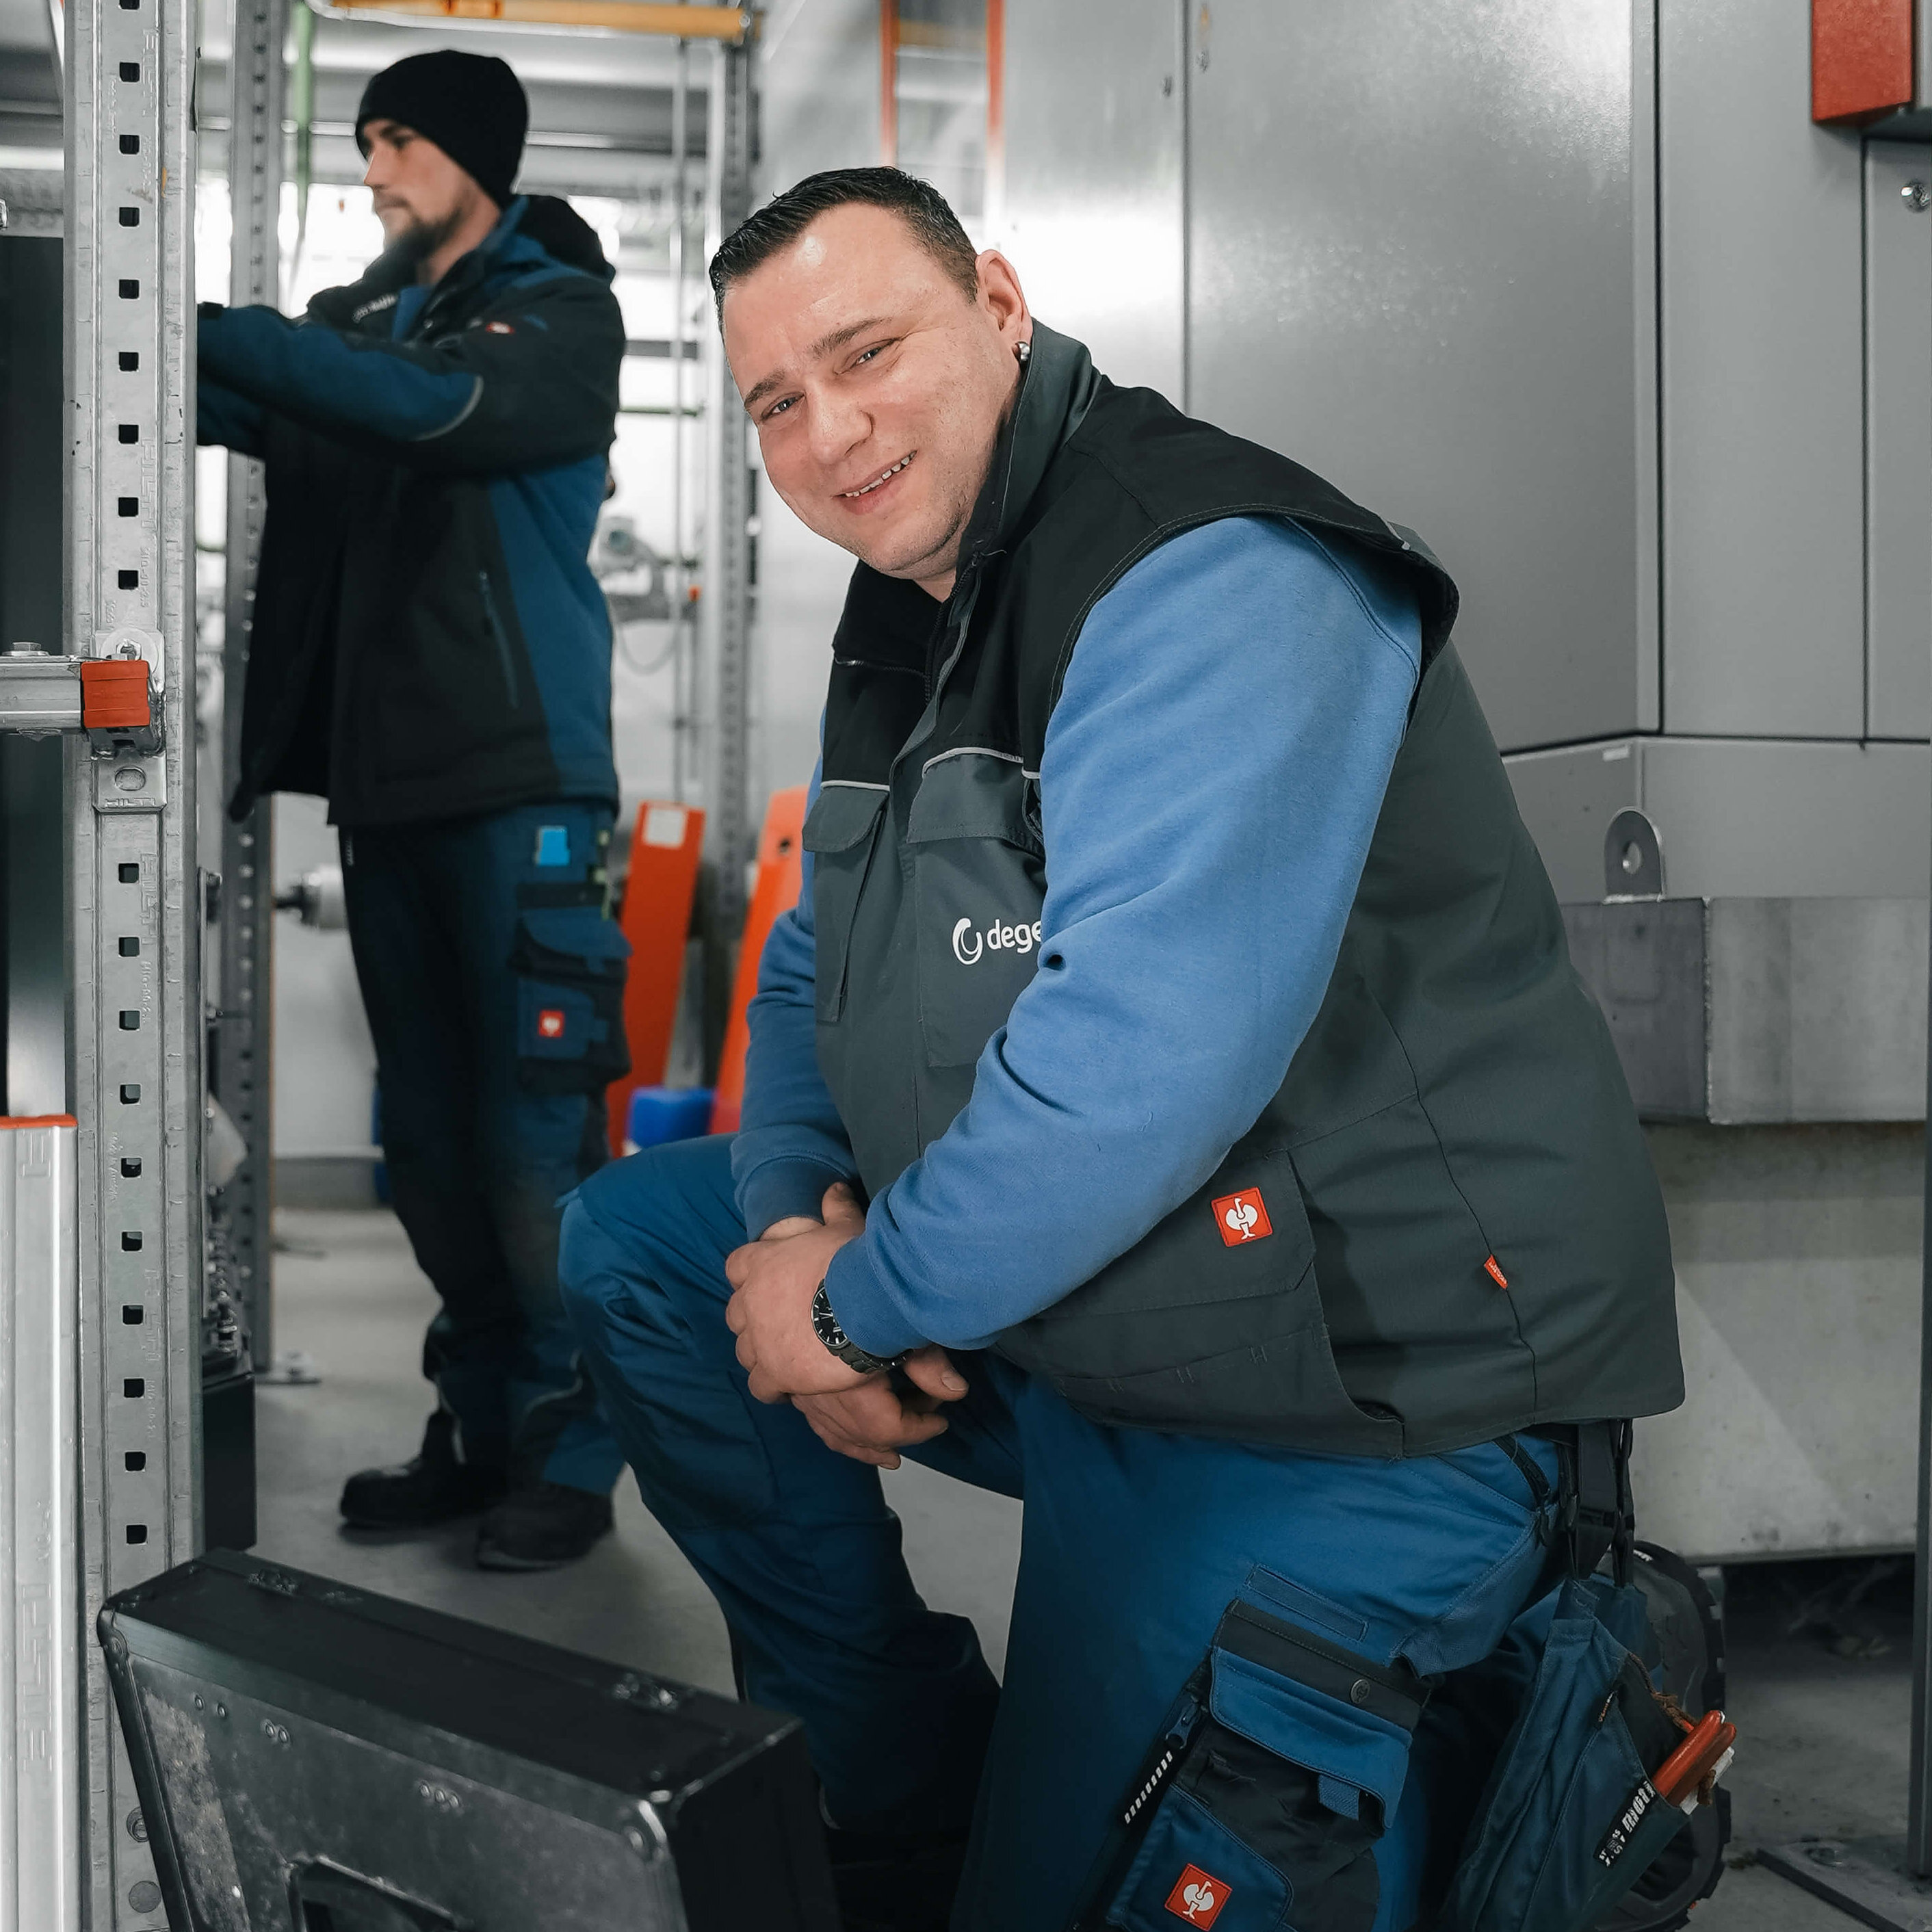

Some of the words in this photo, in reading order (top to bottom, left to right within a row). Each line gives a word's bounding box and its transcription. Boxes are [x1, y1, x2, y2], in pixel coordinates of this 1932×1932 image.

[140, 438, 156, 530] HILTI
[104, 797, 156, 808] HILTI
[987, 919, 1042, 954] dege
[22, 1583, 52, 1774] HILTI
